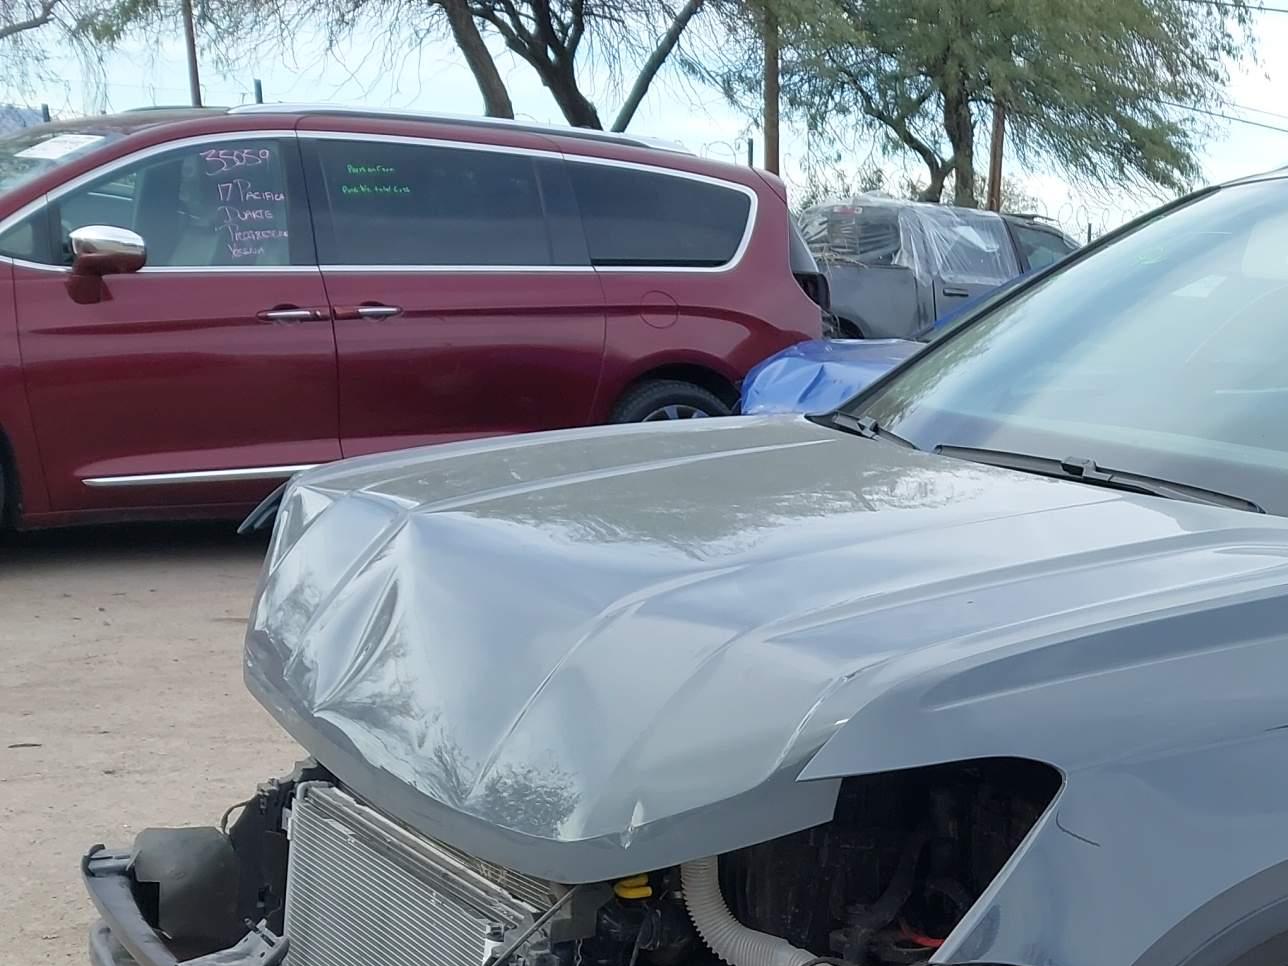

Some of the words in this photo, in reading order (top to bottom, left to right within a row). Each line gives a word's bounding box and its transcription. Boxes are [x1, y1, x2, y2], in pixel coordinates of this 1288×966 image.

[200, 149, 269, 175] 35059
[217, 183, 232, 201] 17
[233, 179, 284, 202] PACIFICA
